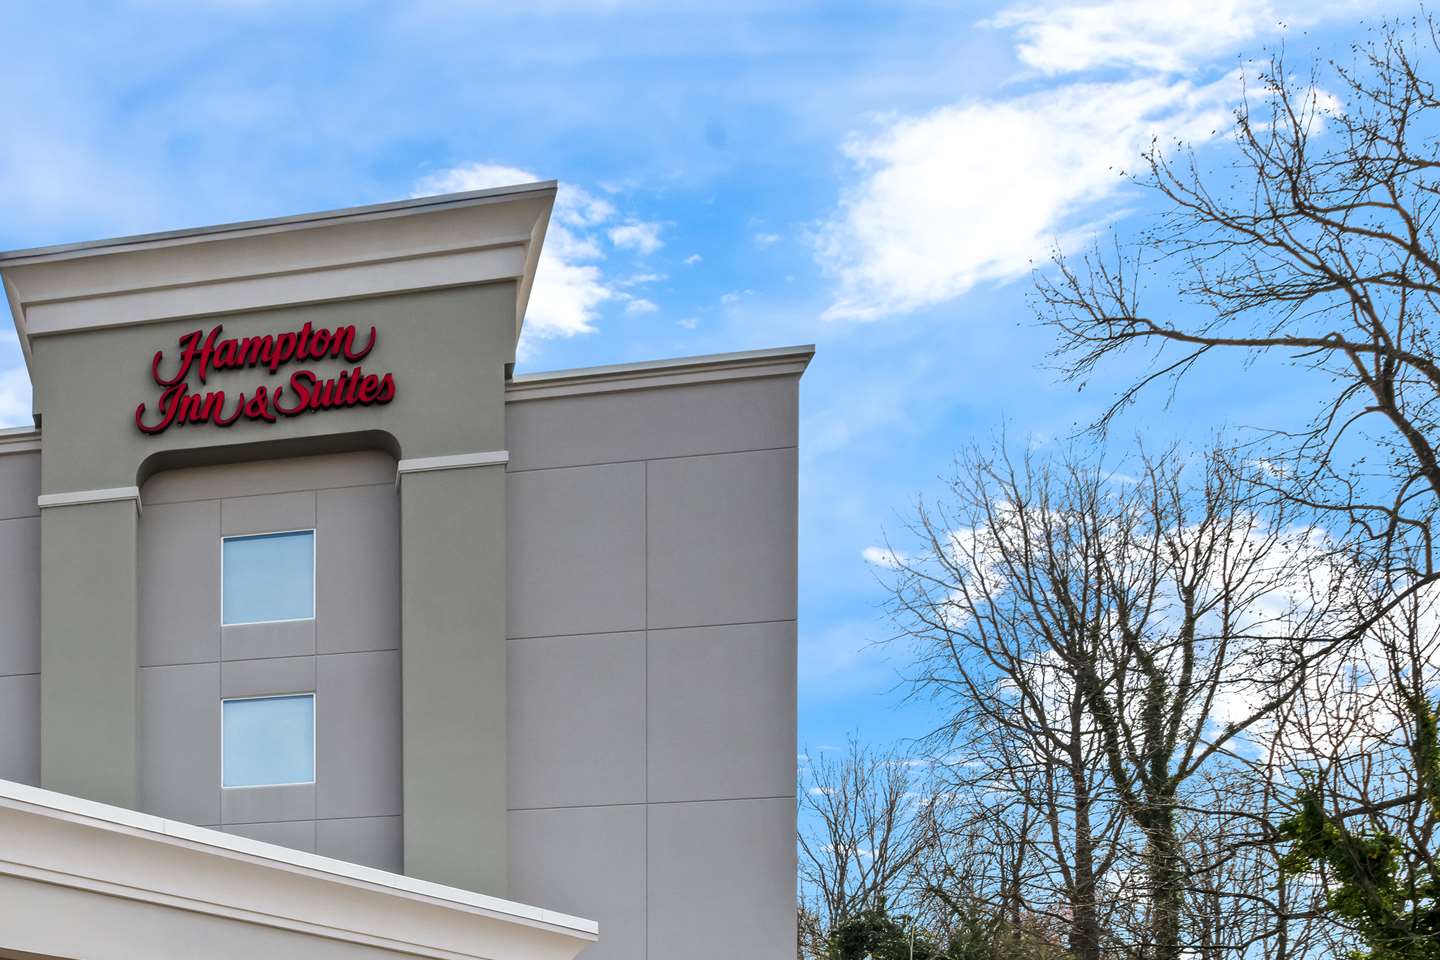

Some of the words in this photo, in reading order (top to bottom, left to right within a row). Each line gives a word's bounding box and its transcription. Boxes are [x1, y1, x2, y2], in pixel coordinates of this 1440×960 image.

[152, 321, 377, 387] Hampton
[135, 382, 245, 435] Inn
[245, 386, 276, 423] &
[272, 366, 396, 417] Suites
